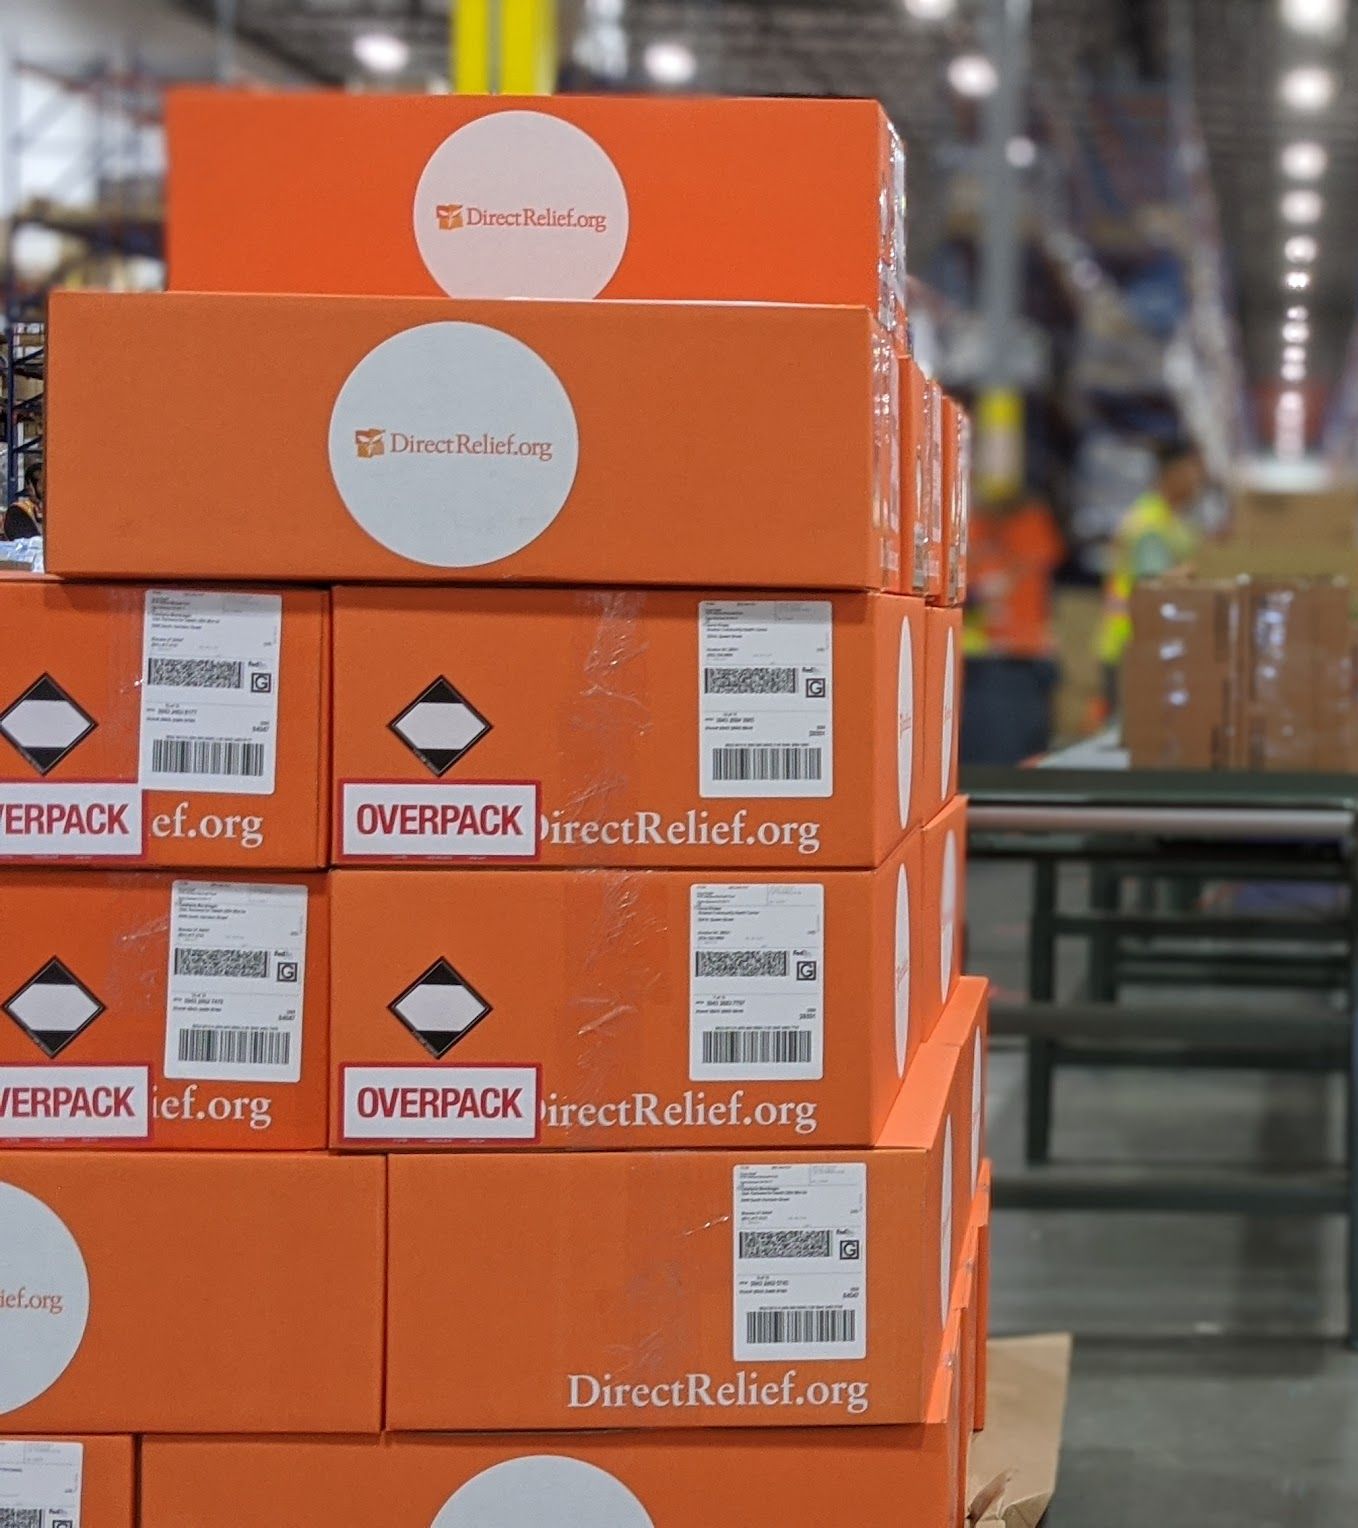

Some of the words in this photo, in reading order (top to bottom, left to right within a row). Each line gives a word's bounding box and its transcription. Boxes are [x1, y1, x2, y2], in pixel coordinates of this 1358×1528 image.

[467, 206, 607, 232] DirectRelief.org
[390, 432, 553, 461] DirectRelief.org
[356, 804, 523, 836] OVERPACK
[357, 1087, 523, 1119] OVERPACK
[567, 1371, 868, 1414] DirectRelief.org
